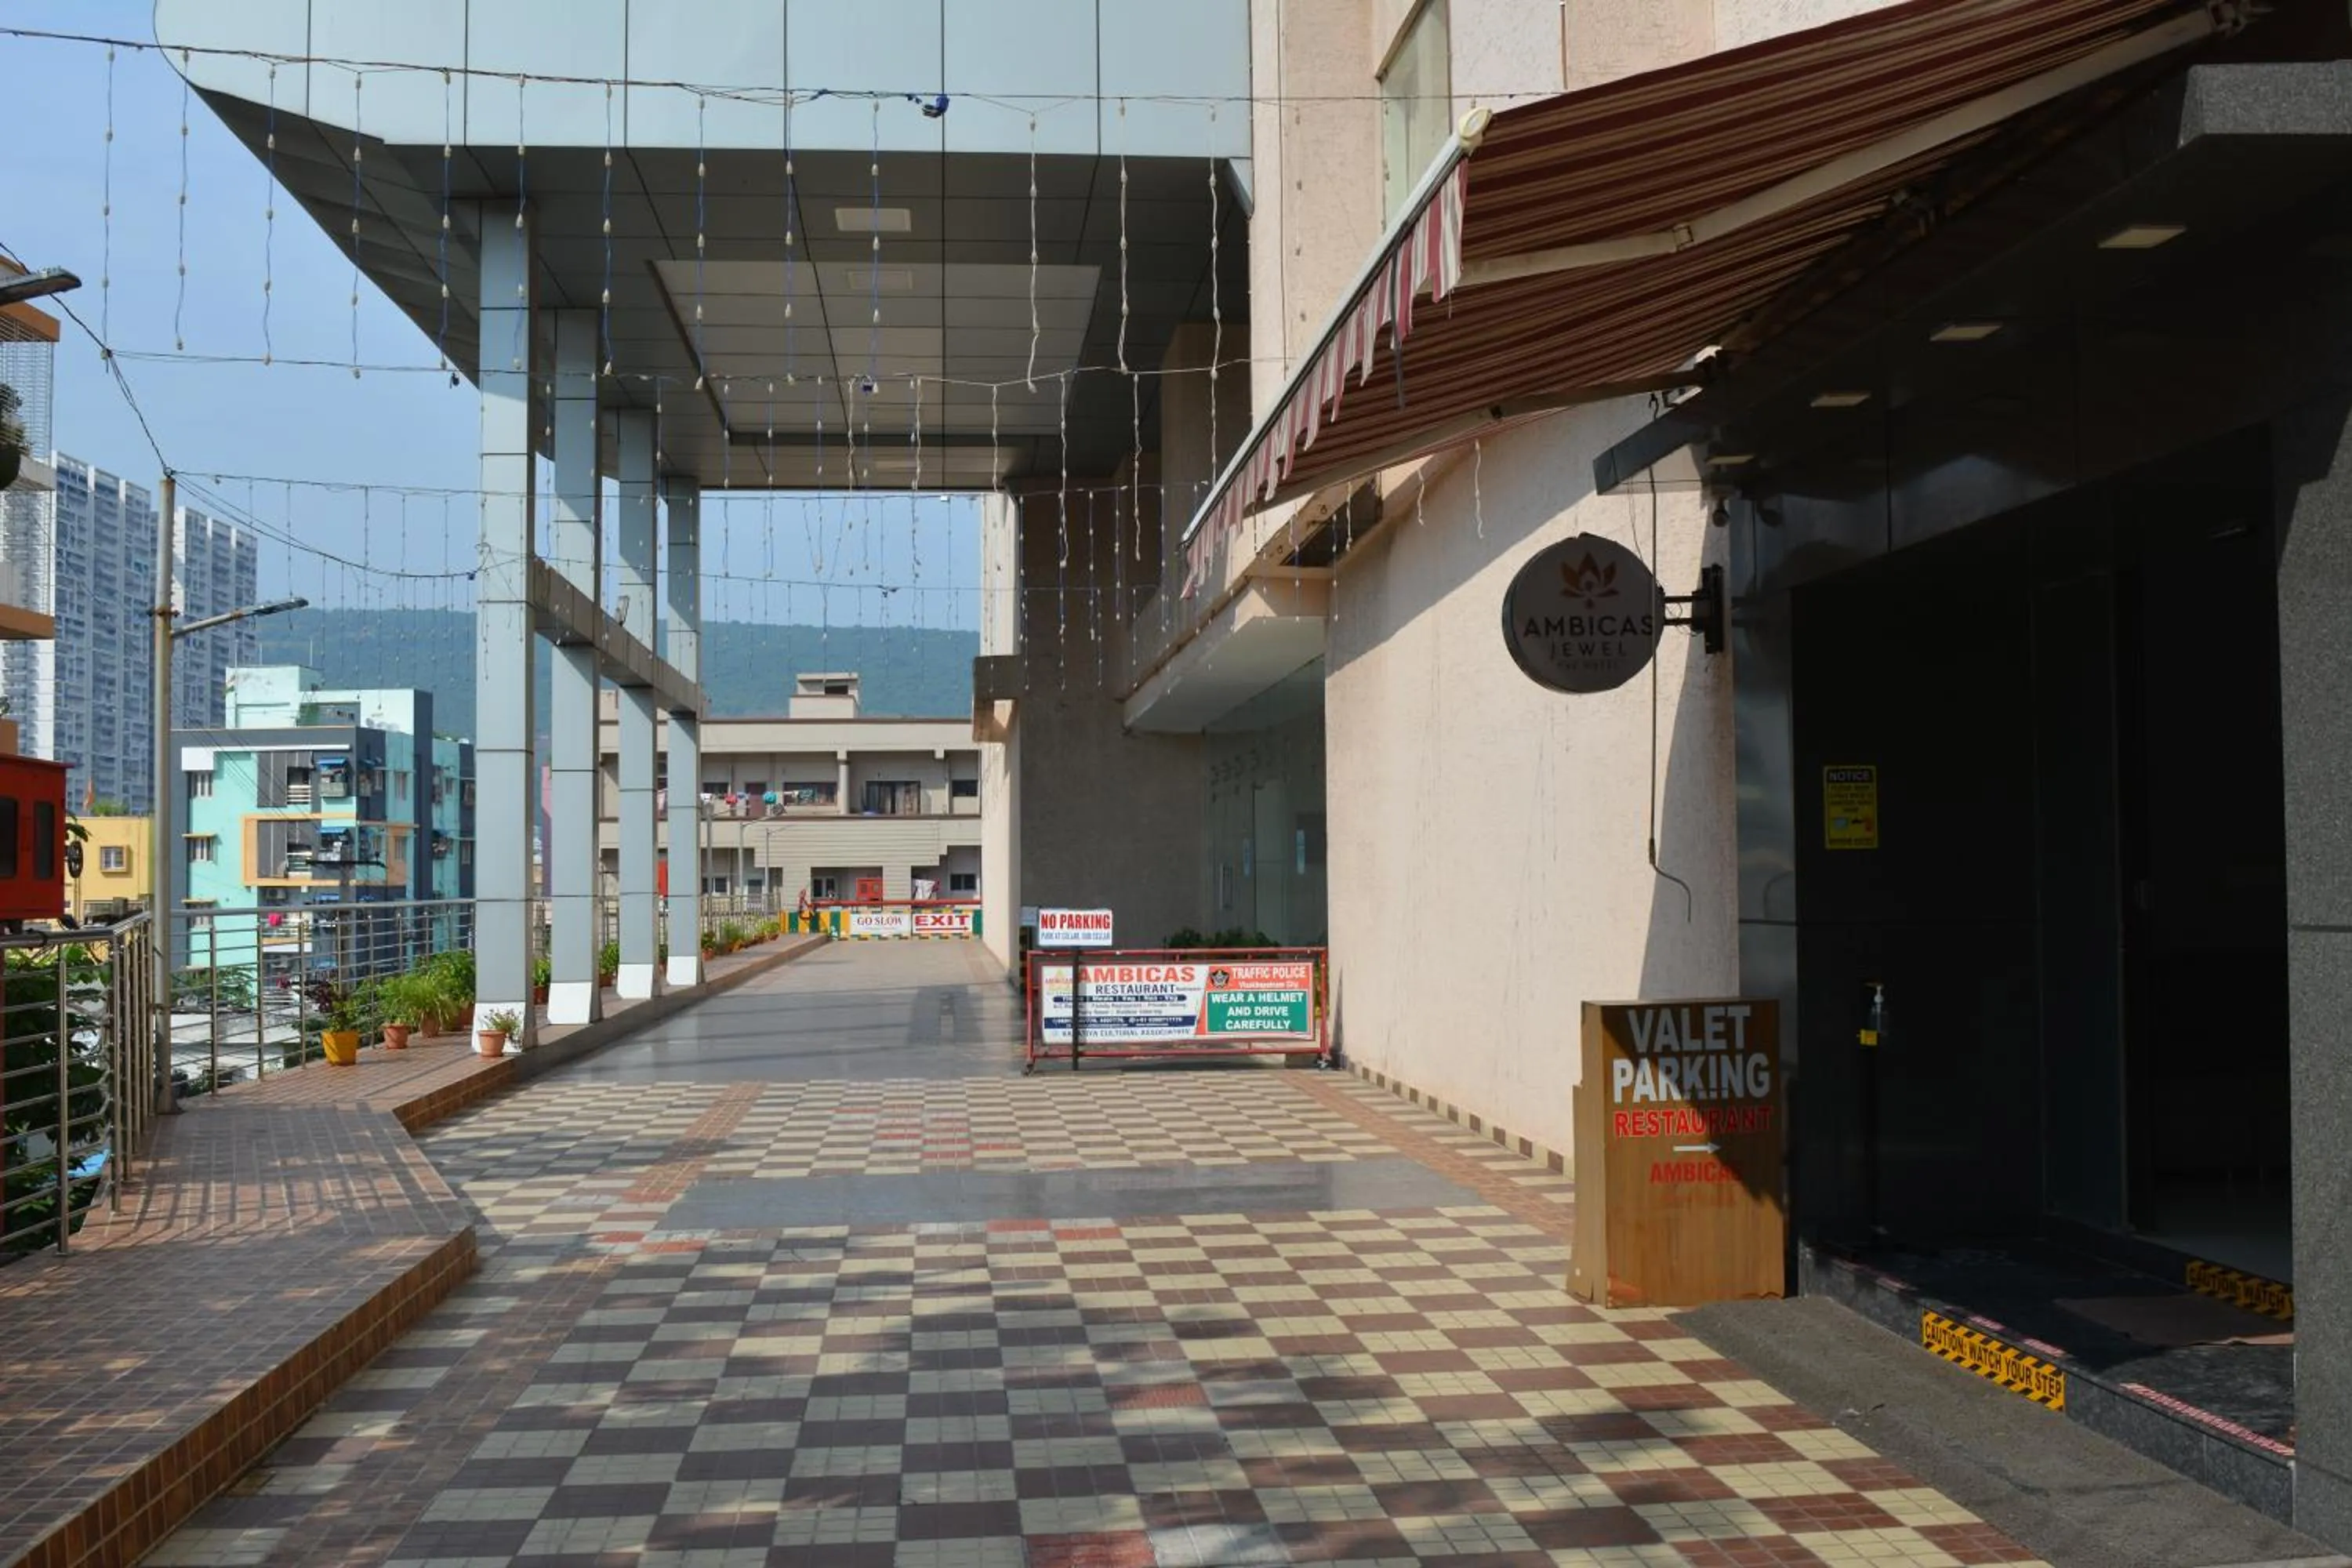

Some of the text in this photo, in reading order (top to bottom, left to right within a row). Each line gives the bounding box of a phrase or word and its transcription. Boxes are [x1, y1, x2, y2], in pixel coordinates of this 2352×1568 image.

[1523, 615, 1653, 637] AMBICAS
[1551, 641, 1627, 660] JEWEL
[1828, 770, 1870, 782] NOTICE
[857, 916, 903, 925] GO SLOW
[915, 915, 970, 926] EXIT
[1041, 913, 1110, 929] NO PARKING
[1079, 966, 1196, 983] AMBICAS
[1232, 966, 1306, 979] TRAFFIC POLICE
[1095, 984, 1176, 995] RESTAURANT
[1211, 992, 1304, 1004] WEAR A HELMET
[1227, 1006, 1288, 1017] AND DRIVE
[1225, 1020, 1291, 1029] CAREFULLY
[1627, 1004, 1752, 1053] VALET
[1613, 1053, 1771, 1104] PARKING
[1614, 1105, 1773, 1138] RESTAURANT
[2244, 1283, 2285, 1311] WATCH
[1924, 1321, 2062, 1398] CAUTION: WATCH YOUR STEP
